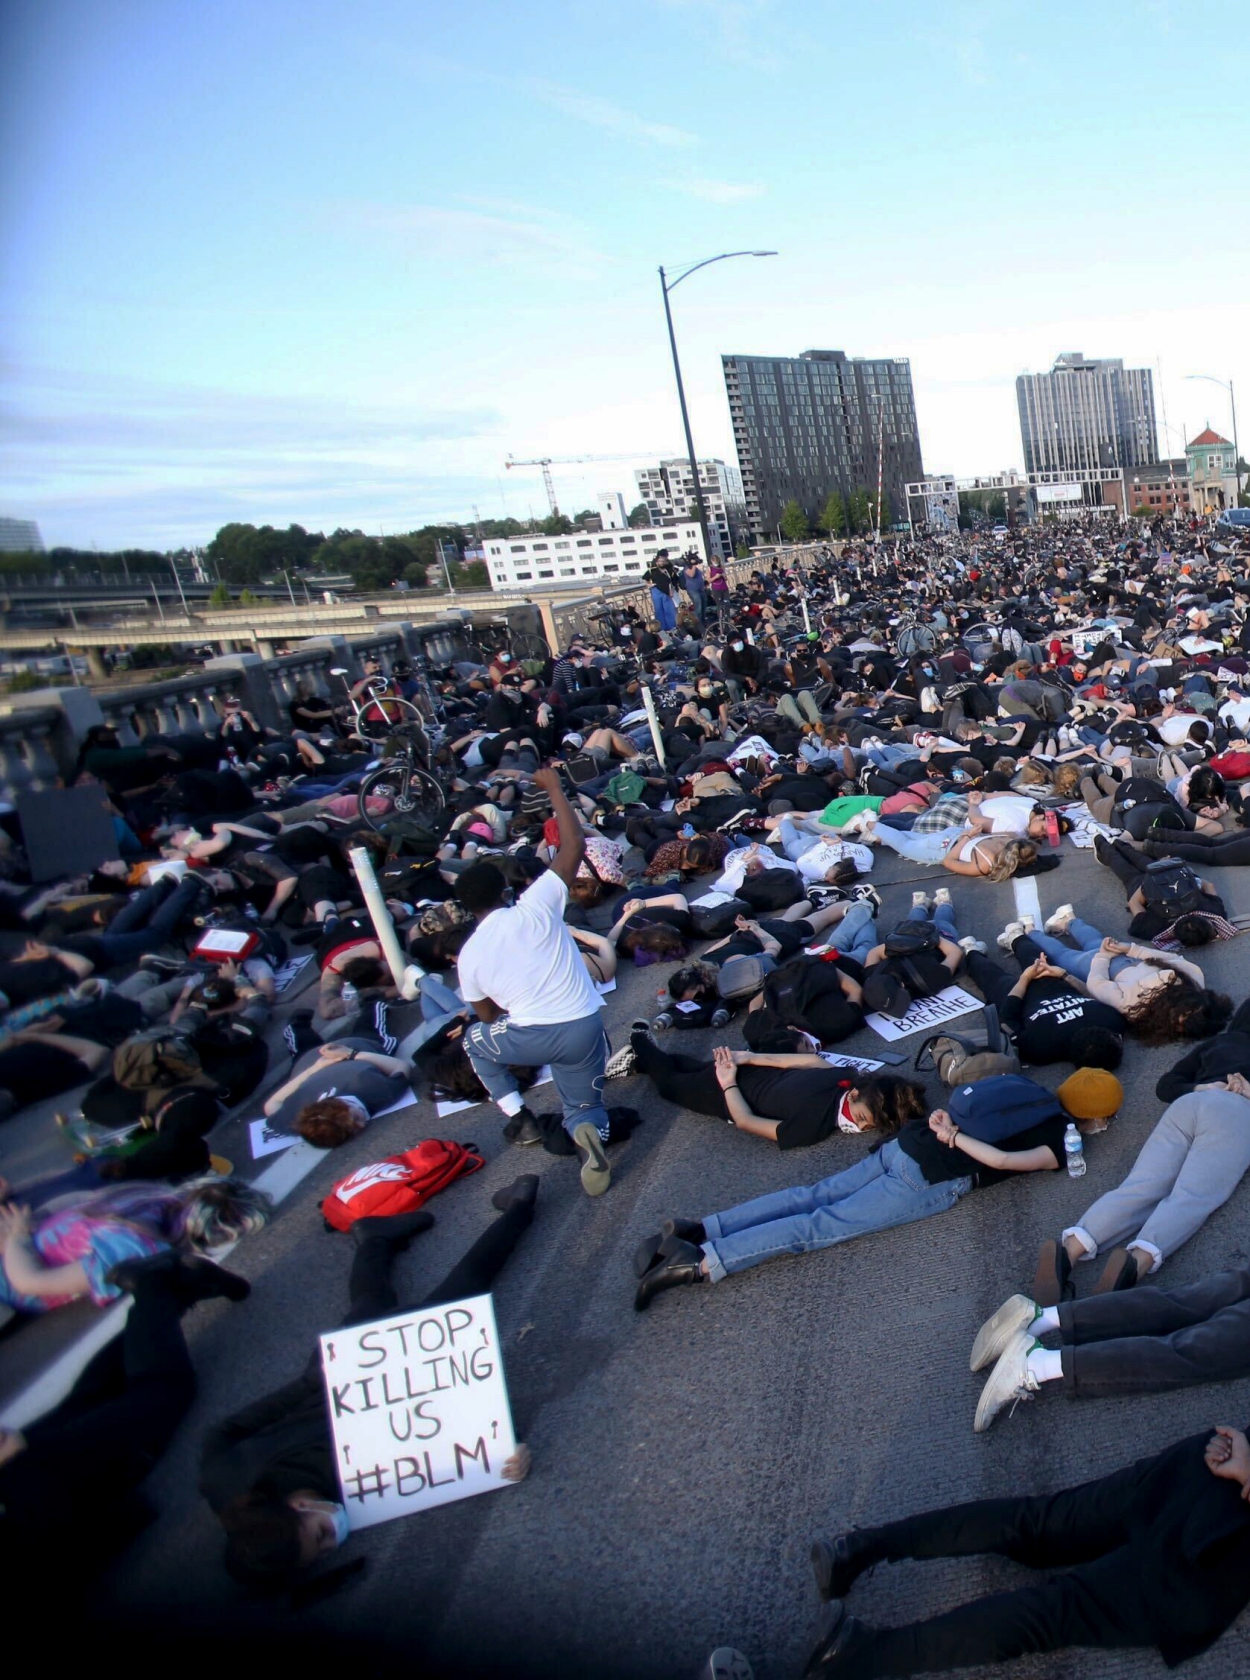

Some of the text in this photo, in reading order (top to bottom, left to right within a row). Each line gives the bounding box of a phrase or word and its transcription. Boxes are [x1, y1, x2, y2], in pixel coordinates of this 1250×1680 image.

[892, 995, 977, 1033] BREATHE
[1056, 1006, 1084, 1025] ART
[834, 1057, 877, 1071] FIGHT
[357, 1308, 473, 1368] STOP
[332, 1346, 493, 1418] KILLING
[389, 1400, 442, 1441] US
[344, 1436, 491, 1504] #BLM
